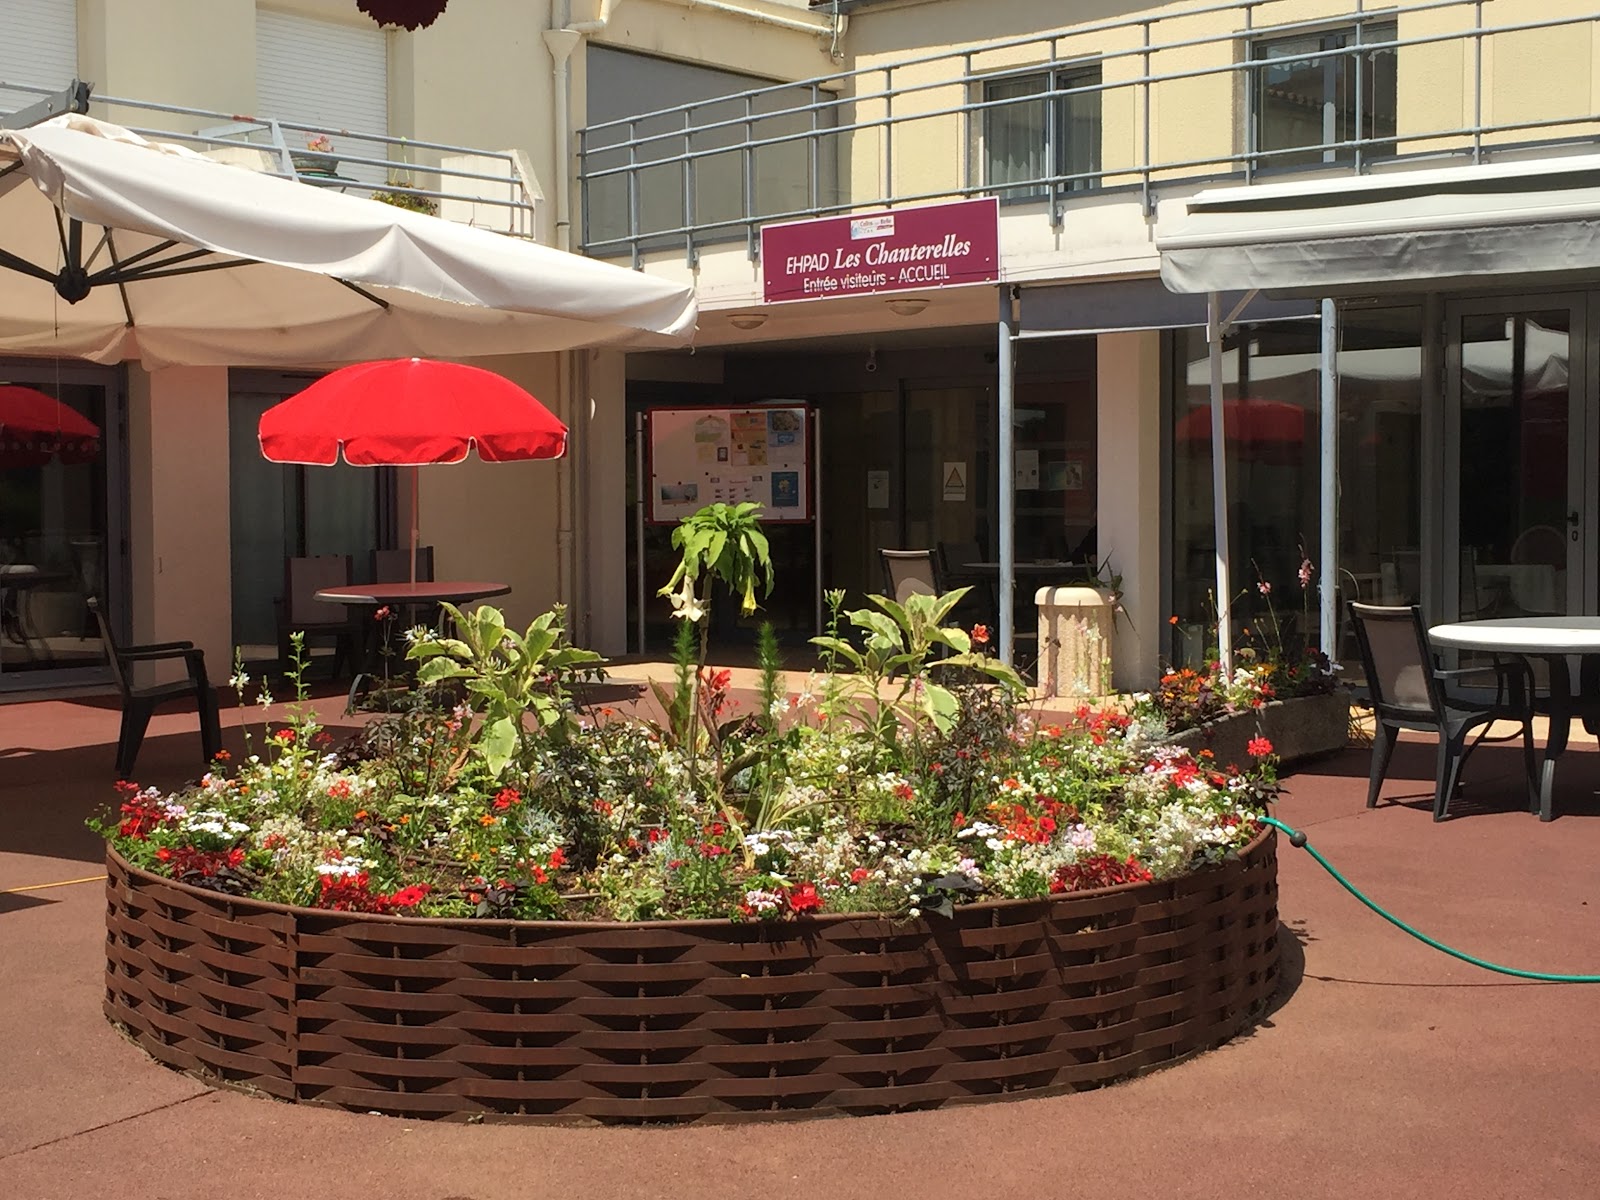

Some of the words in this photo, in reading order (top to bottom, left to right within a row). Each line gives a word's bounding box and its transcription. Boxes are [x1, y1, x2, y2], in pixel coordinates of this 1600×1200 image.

[786, 253, 829, 275] EHPAD
[833, 248, 861, 270] Les
[865, 234, 971, 266] Chanterelles
[803, 275, 838, 293] Entrée
[840, 271, 887, 290] visiteurs
[897, 263, 950, 284] ACCUEIL
